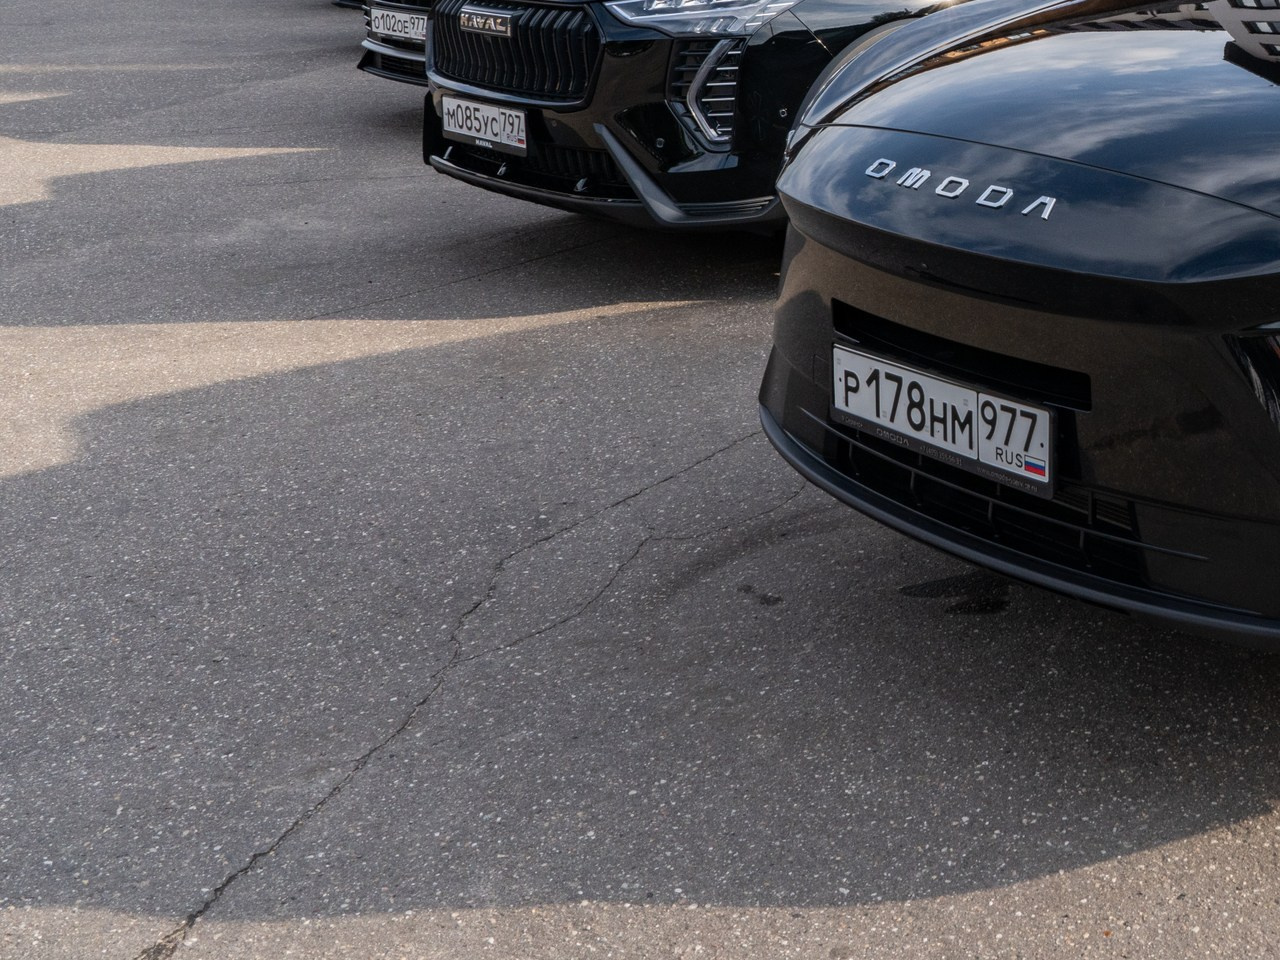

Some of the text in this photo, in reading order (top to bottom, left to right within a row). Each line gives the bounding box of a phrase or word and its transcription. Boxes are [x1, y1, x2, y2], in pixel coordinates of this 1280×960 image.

[374, 13, 426, 34] О102ОЕ 977
[460, 13, 507, 31] HAVAL
[447, 104, 521, 137] М085УС 797
[865, 158, 1057, 221] OMODA
[843, 368, 1038, 452] Р178НМ 977
[995, 447, 1023, 469] RUS
